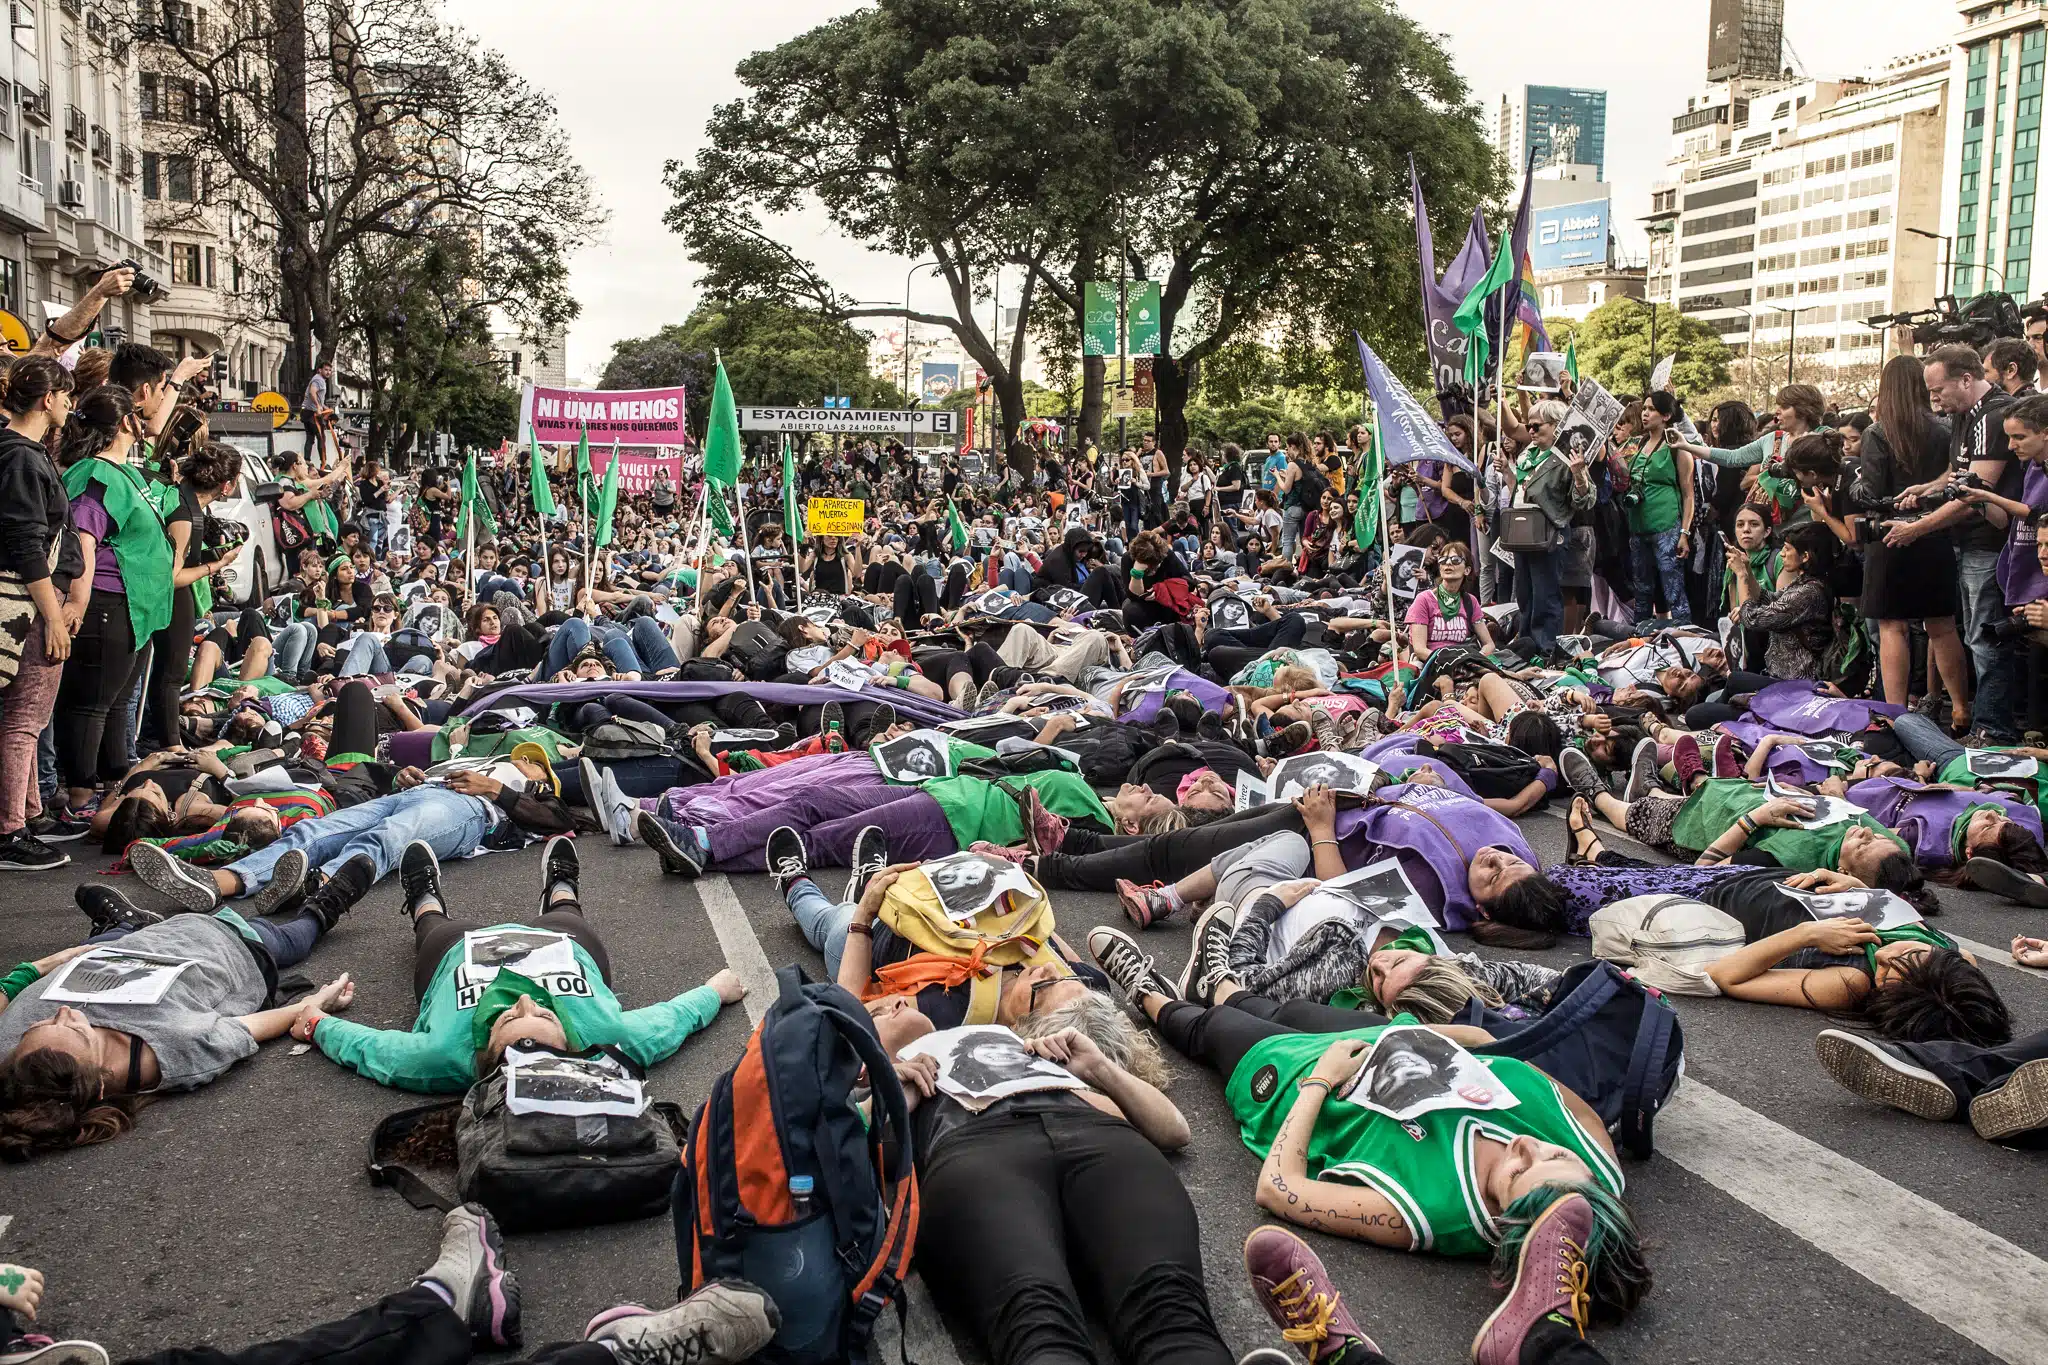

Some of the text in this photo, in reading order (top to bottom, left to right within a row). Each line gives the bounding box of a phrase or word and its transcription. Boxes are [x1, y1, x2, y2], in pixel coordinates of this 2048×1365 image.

[1562, 214, 1600, 232] Abbott
[1086, 310, 1115, 324] G20
[256, 404, 284, 414] Subte
[537, 397, 679, 421] NI UNA MENOS
[752, 408, 925, 422] ESTACIONAMIENTO
[537, 420, 679, 432] VIVAS Y LBRES NOS QUEREMOS
[780, 422, 897, 432] ABIERTO LAS 24 HORAS
[809, 499, 819, 510] NO
[818, 510, 849, 519] MUERTAS
[808, 521, 822, 531] LAS
[2016, 531, 2036, 541] MUJERE
[1433, 616, 1467, 630] NI UNA
[1430, 630, 1467, 642] MENOS
[556, 977, 587, 994] DO
[1256, 1077, 1272, 1096] NBA
